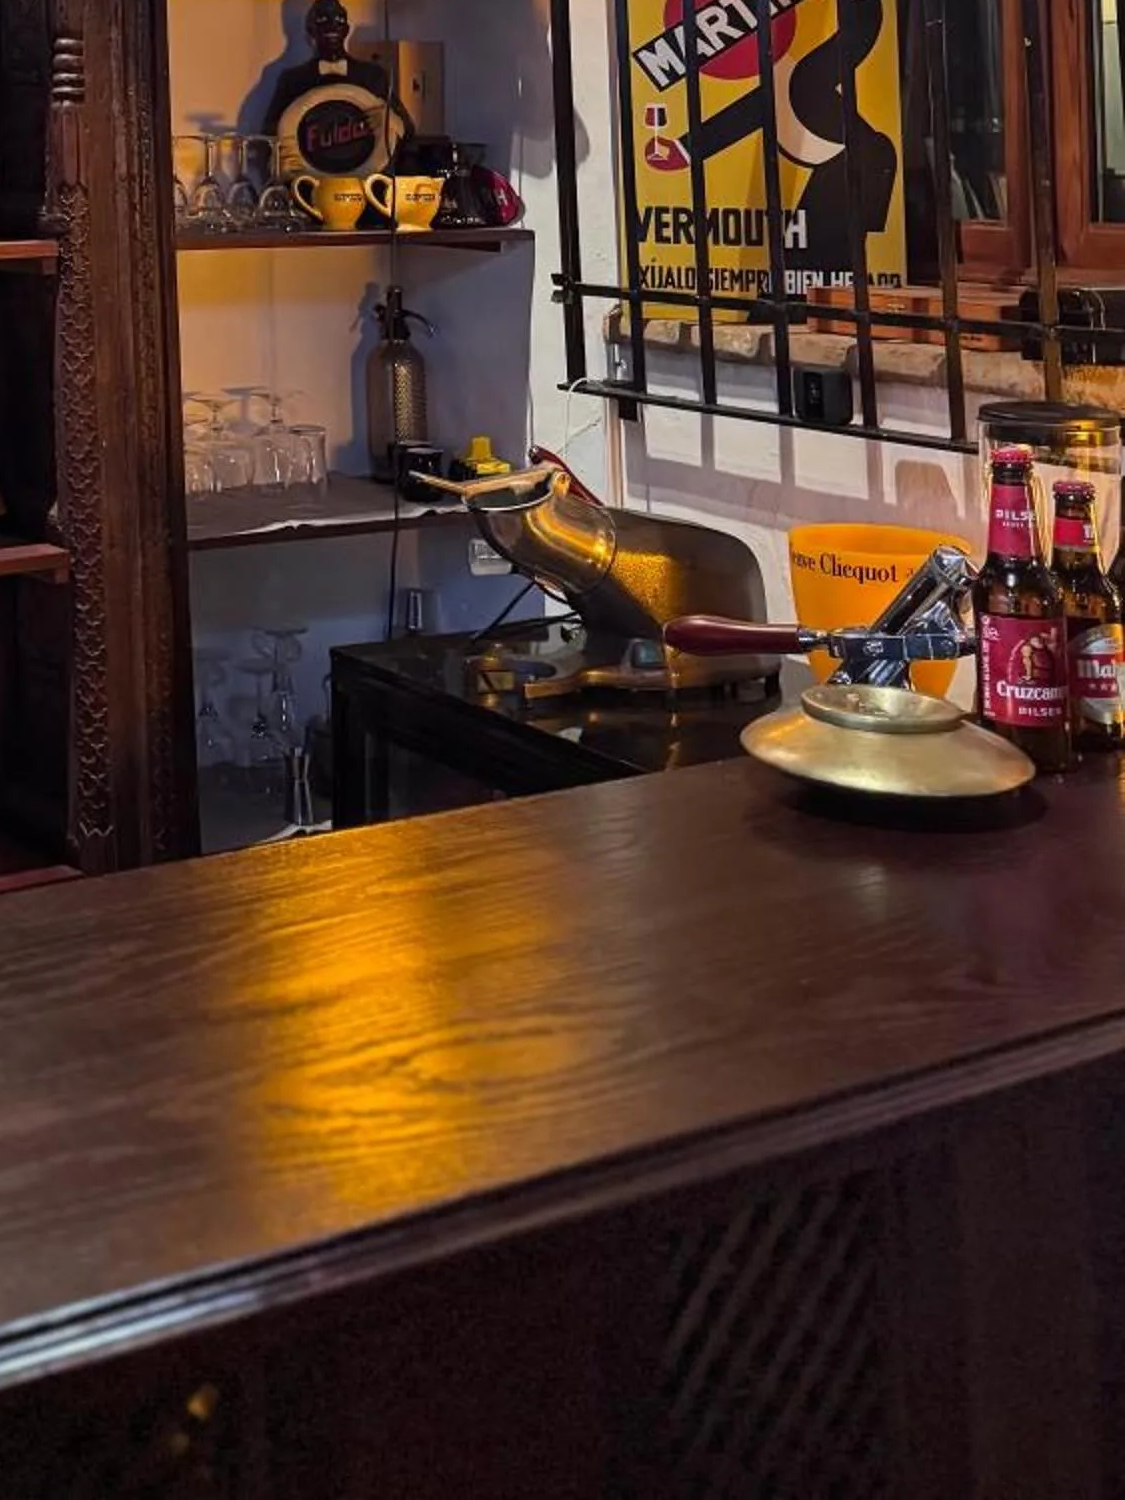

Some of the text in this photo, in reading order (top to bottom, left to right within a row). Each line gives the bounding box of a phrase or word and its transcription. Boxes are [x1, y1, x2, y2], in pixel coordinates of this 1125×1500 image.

[637, 206, 808, 249] VEROUH
[995, 509, 1036, 522] PILS
[820, 552, 897, 584] Clicquot
[996, 680, 1068, 701] Cruzcam
